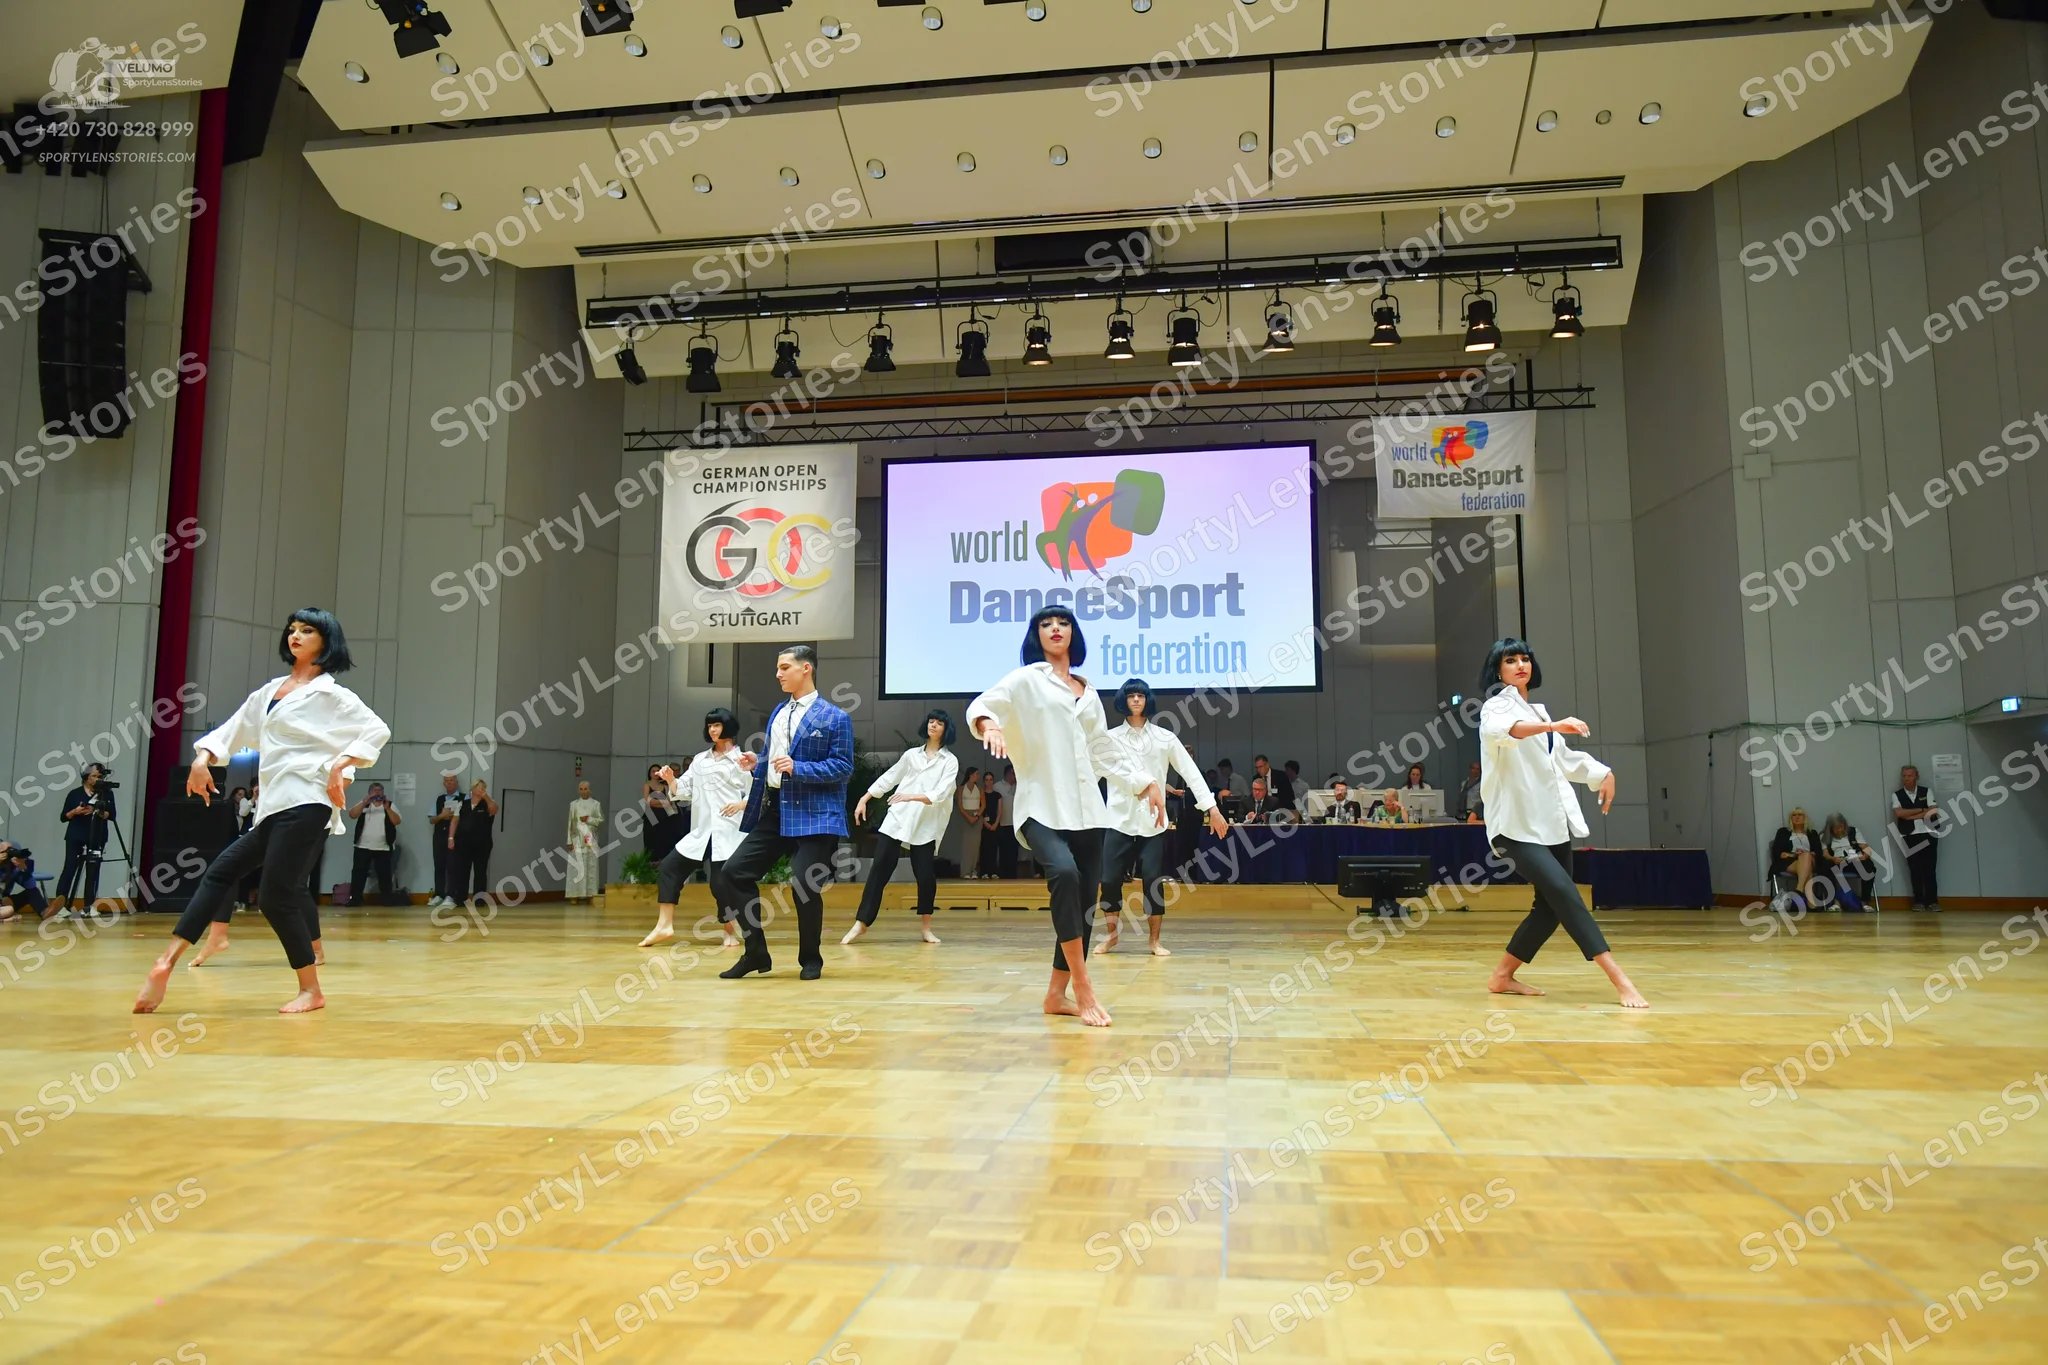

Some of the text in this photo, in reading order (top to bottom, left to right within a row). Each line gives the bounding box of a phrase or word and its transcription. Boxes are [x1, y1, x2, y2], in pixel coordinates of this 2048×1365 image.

[1392, 442, 1427, 461] world
[702, 464, 818, 479] GERMAN OPEN
[1392, 464, 1524, 490] DanceSport
[692, 478, 827, 494] CHAMPIONSHIPS
[1461, 492, 1525, 511] federation
[950, 520, 1028, 563] world
[950, 572, 1246, 629] DanceSport
[709, 609, 802, 627] STUTTGART
[1100, 632, 1247, 675] federation
